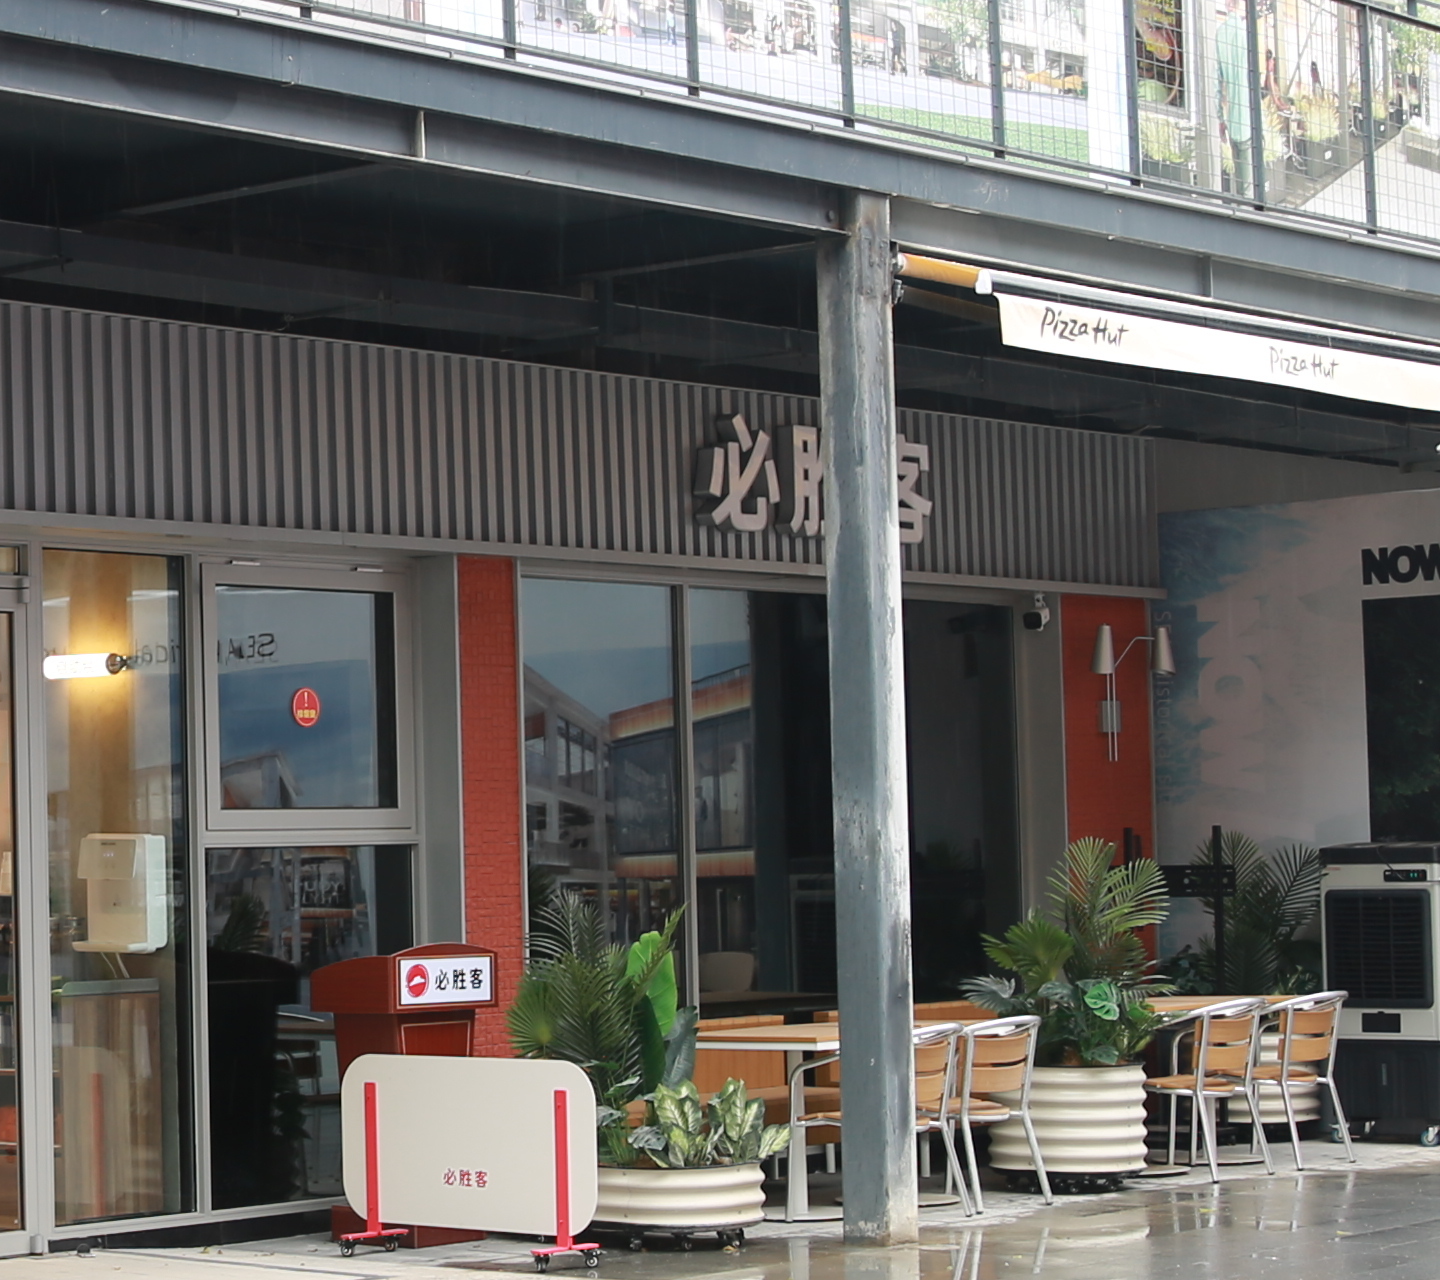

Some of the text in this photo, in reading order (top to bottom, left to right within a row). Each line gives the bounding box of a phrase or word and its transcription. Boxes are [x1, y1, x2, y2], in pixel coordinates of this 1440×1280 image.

[1039, 306, 1130, 349] Pizza Hut
[1269, 345, 1340, 381] Pizza Hut
[434, 968, 484, 991] 必胜客
[443, 1168, 488, 1188] 必胜客
